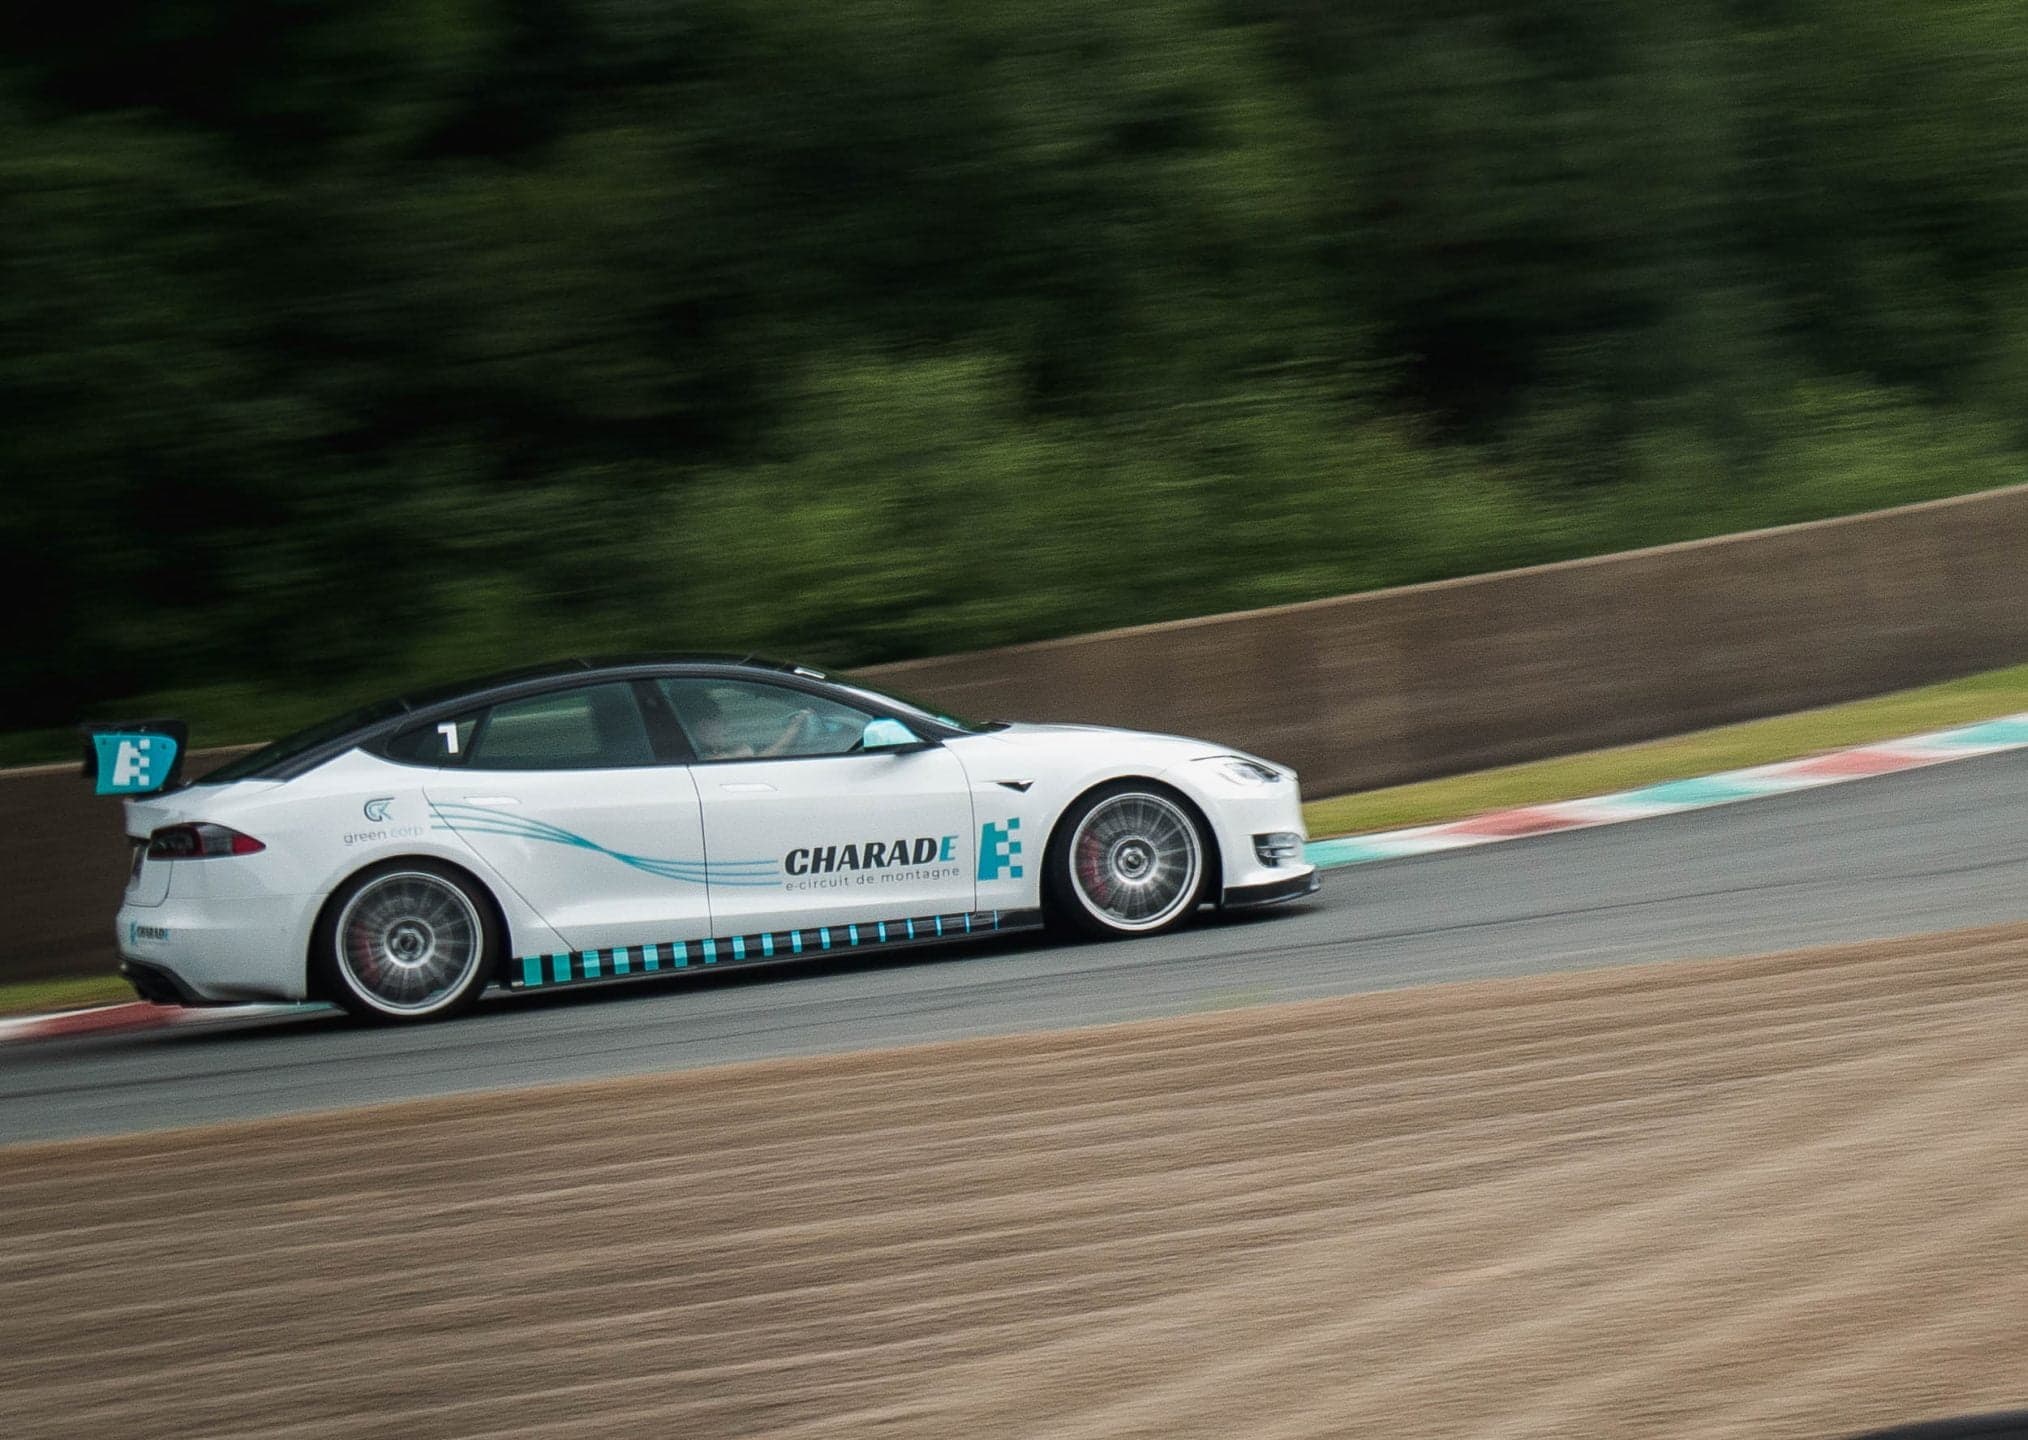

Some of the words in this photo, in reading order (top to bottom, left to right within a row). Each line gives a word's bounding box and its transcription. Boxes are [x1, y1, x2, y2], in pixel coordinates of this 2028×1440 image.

[437, 722, 459, 754] 1
[343, 830, 388, 846] green
[390, 827, 424, 841] corp
[785, 835, 958, 876] CHARADE
[785, 876, 850, 892] e-circuit
[856, 873, 875, 886] de
[881, 866, 960, 883] montagne
